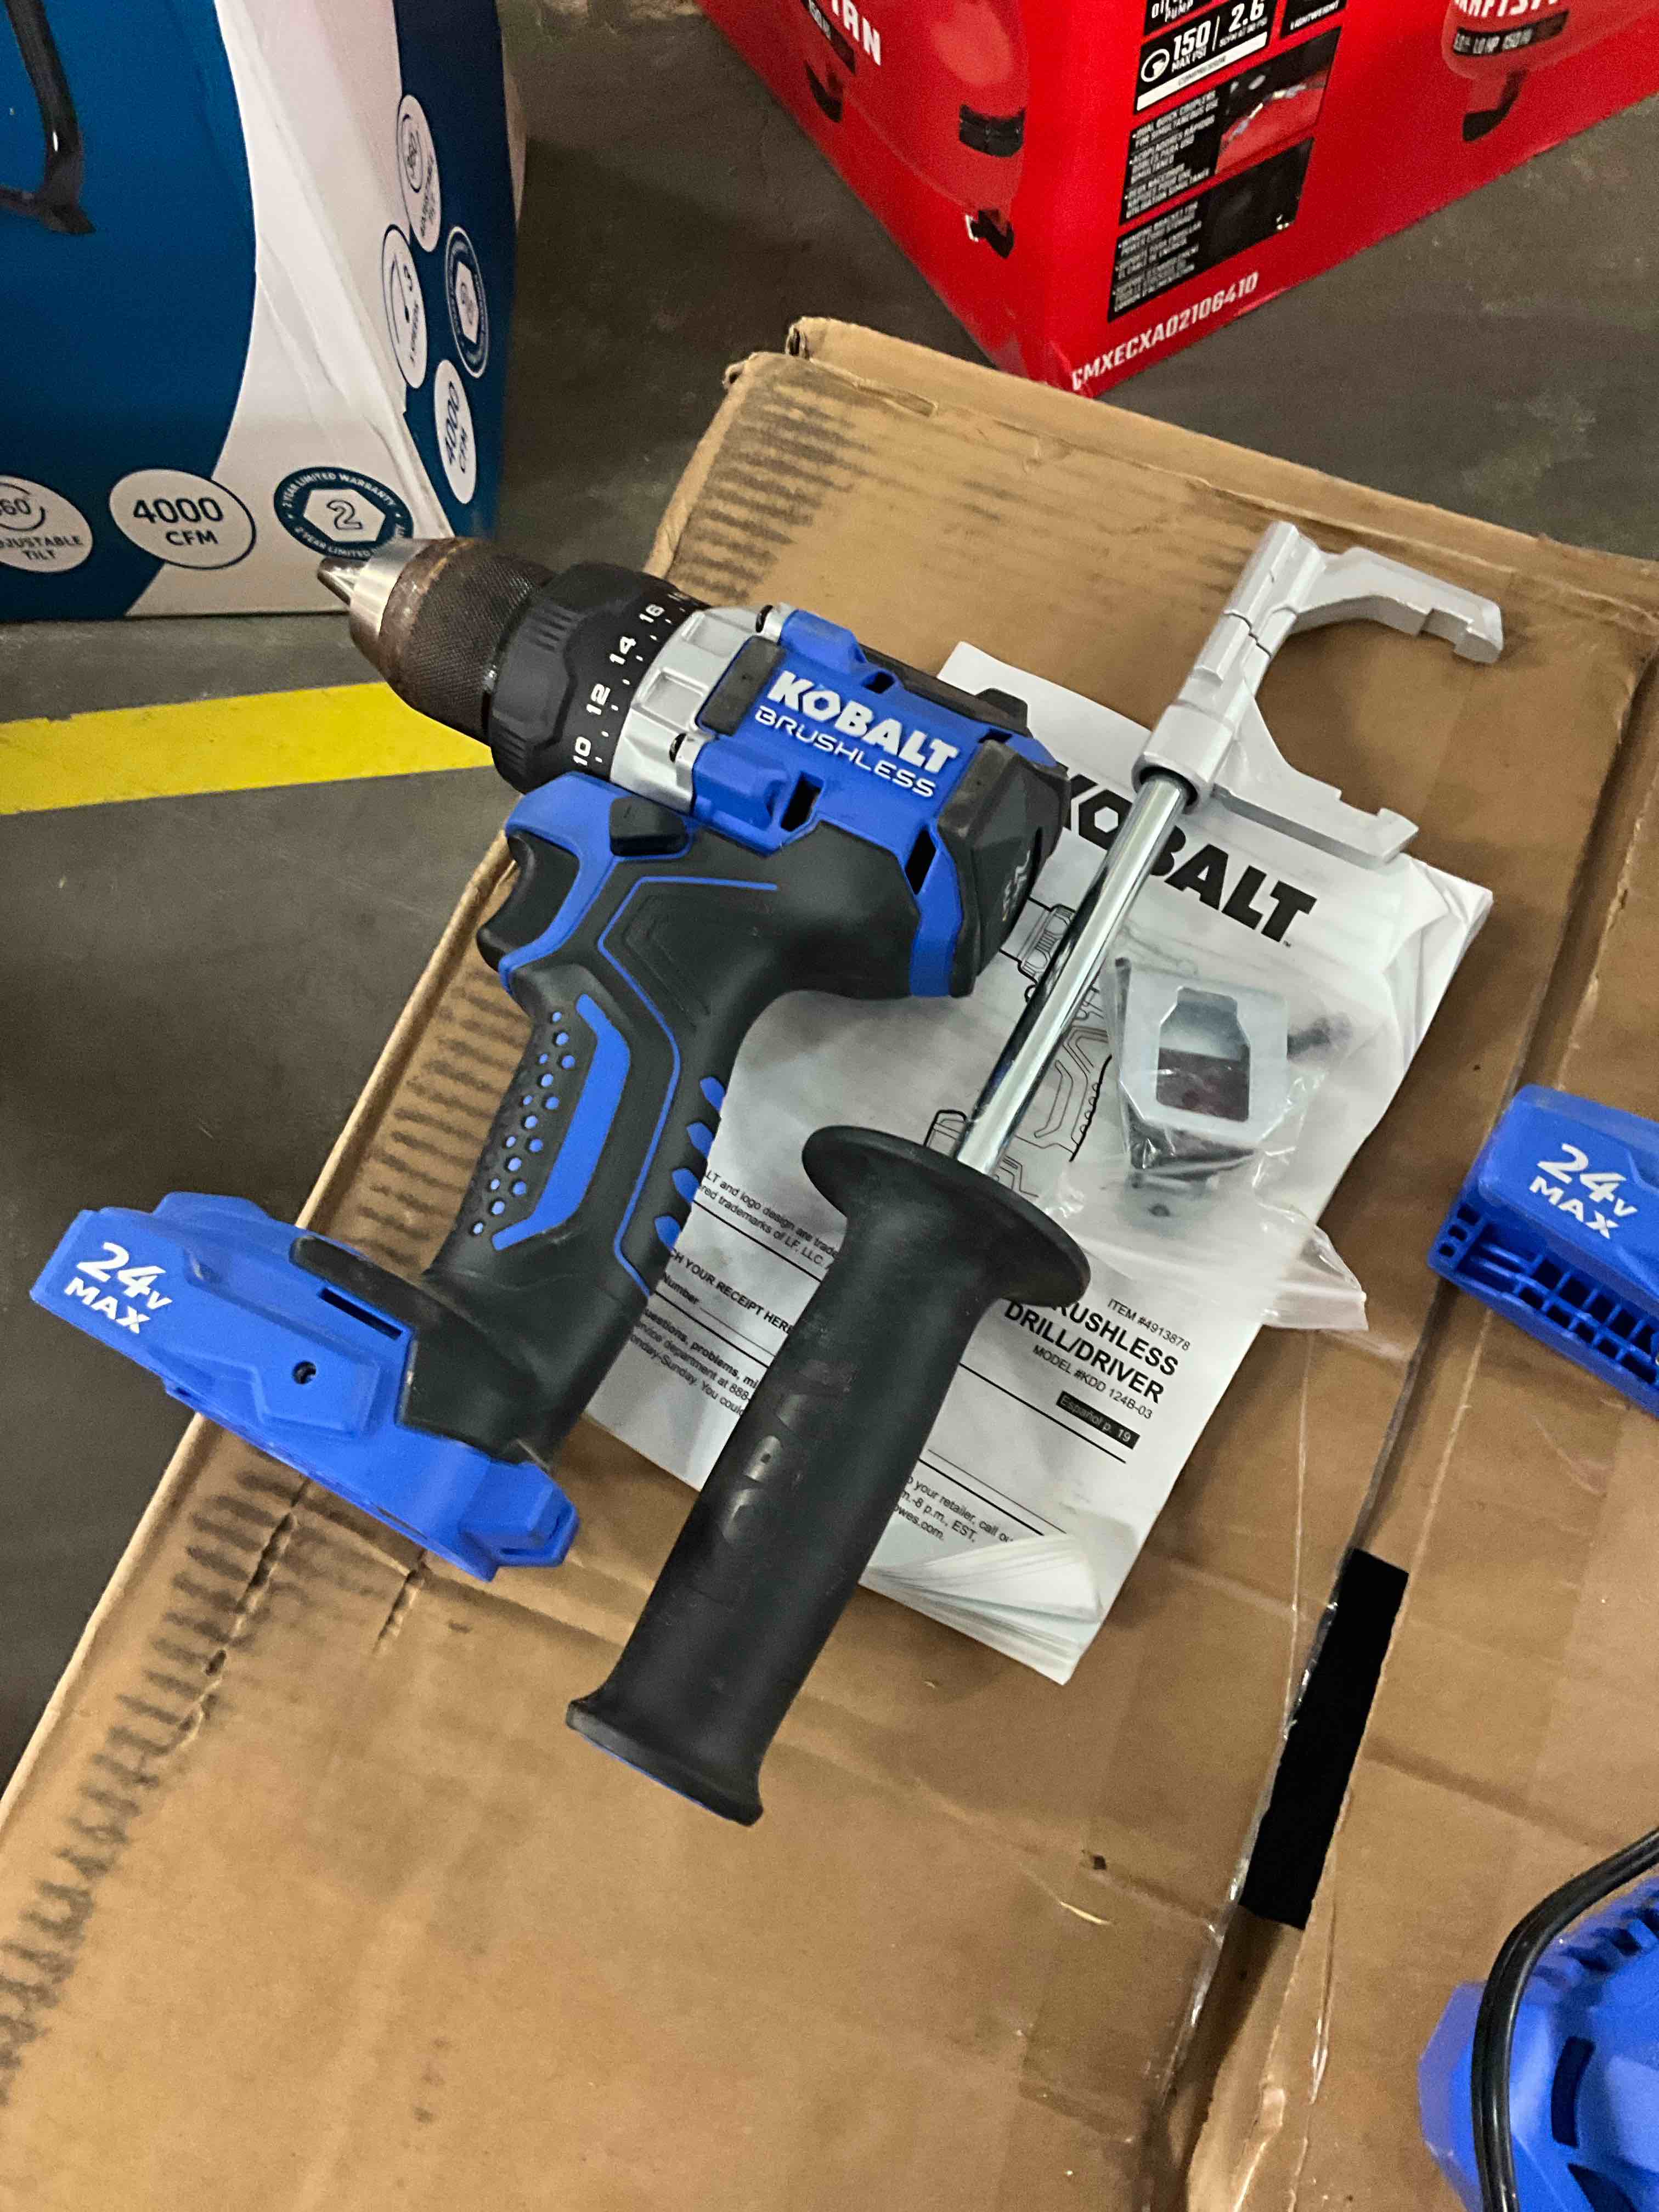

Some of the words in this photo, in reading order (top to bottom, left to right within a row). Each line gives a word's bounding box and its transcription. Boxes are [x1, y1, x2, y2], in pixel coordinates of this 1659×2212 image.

[1229, 0, 1265, 32] 2.6
[1174, 20, 1211, 60] 150
[1071, 271, 1259, 391] CMXECXA02106410
[445, 380, 460, 464] 4000
[0, 498, 31, 516] 60
[133, 497, 224, 524] 4000
[296, 472, 336, 487] LIMITED
[338, 472, 396, 506] WARRANTY
[165, 530, 219, 546] CFM
[327, 500, 363, 531] 2
[610, 636, 637, 665] 14
[586, 684, 611, 715] 12
[767, 670, 958, 774] KOBALT
[573, 737, 592, 766] 10
[754, 705, 936, 798] BRUSHLESS
[719, 1181, 740, 1197] and
[740, 1192, 761, 1211] logo
[762, 1206, 795, 1231] design
[796, 1227, 813, 1242] are
[719, 1195, 771, 1234] trademarks
[1528, 1175, 1621, 1239] MAX
[64, 1277, 151, 1334] MAX
[685, 1259, 716, 1285] YOUR
[716, 1282, 765, 1316] RECEIPT
[644, 1308, 689, 1344] uestions,
[690, 1342, 740, 1380] problems,
[1108, 1299, 1137, 1321] ITEM
[1137, 1317, 1190, 1352] #4913878
[663, 1339, 717, 1381] department
[718, 1376, 729, 1389] at
[1005, 1301, 1165, 1404] DRILL/DRIVER
[701, 1380, 719, 1400] You
[1032, 1345, 1073, 1375] MODEL
[1073, 1369, 1107, 1393] #KDD
[1109, 1388, 1153, 1420] 124B-03
[1116, 1429, 1132, 1443] 19
[913, 1480, 941, 1500] your
[939, 1493, 977, 1526] retailer,
[978, 1520, 999, 1536] call
[951, 1520, 977, 1543] EST.
